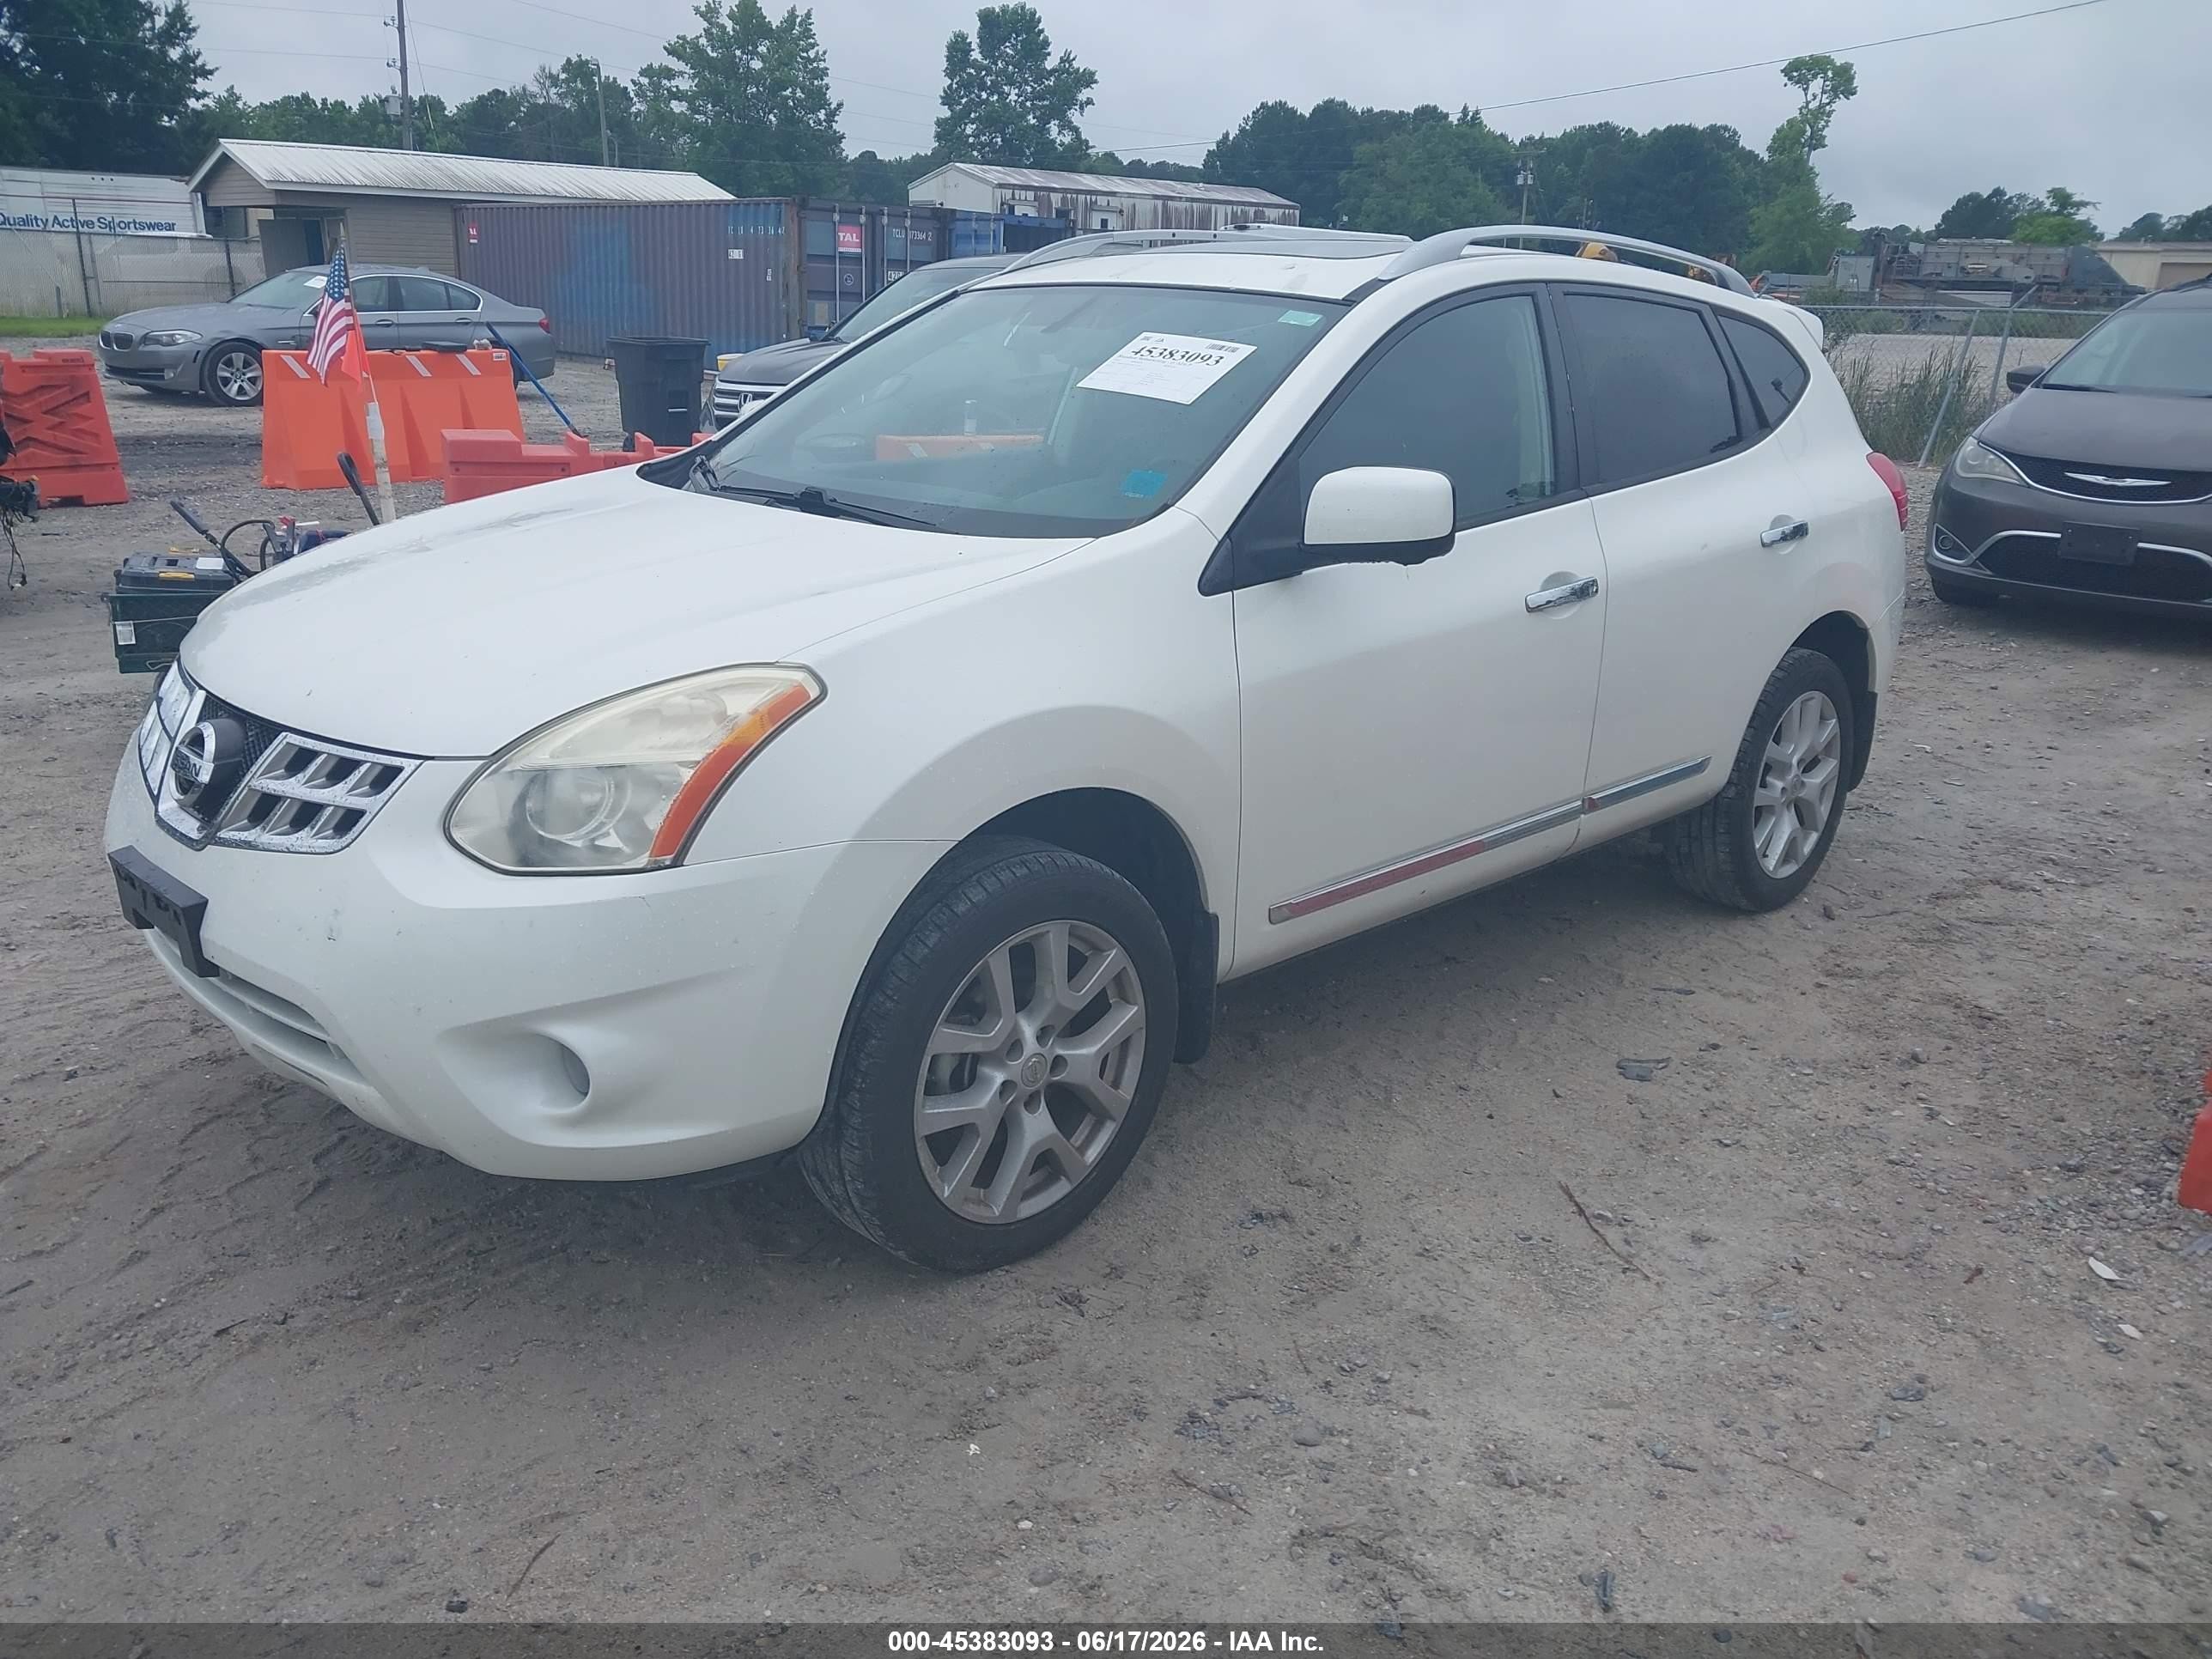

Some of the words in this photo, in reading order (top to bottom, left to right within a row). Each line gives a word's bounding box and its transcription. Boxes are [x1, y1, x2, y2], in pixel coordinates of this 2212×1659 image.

[52, 215, 95, 229] Actve
[838, 232, 860, 242] TAL
[893, 228, 906, 239] TCLU
[1131, 345, 1224, 367] 45383093
